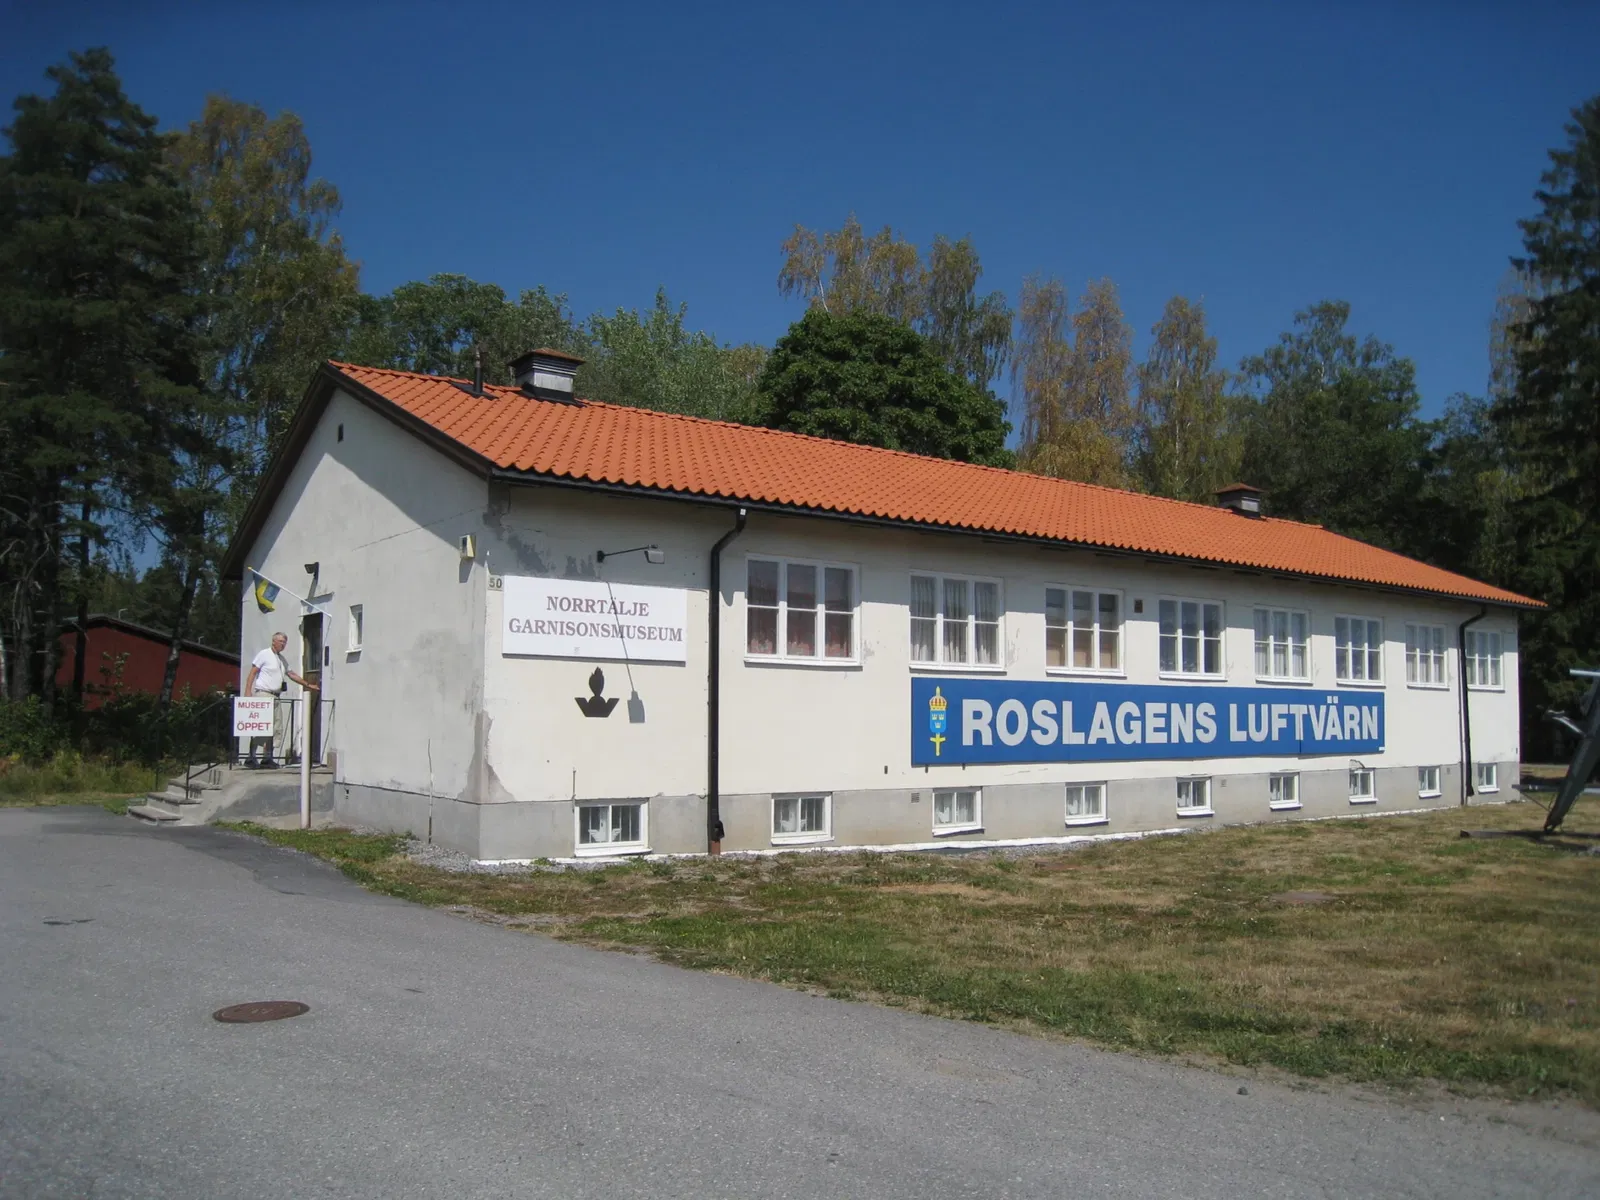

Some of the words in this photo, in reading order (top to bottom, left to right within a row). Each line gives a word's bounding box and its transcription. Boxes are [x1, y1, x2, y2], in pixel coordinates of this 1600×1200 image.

[489, 578, 502, 588] 50
[546, 596, 649, 617] NORRTÄLJE
[509, 618, 683, 642] GARNISONSMUSEUM
[248, 711, 260, 719] ÄR
[962, 698, 1218, 747] ROSLAGENS
[1229, 695, 1379, 742] LUFTVÄRN
[237, 721, 271, 731] ÖPPET
